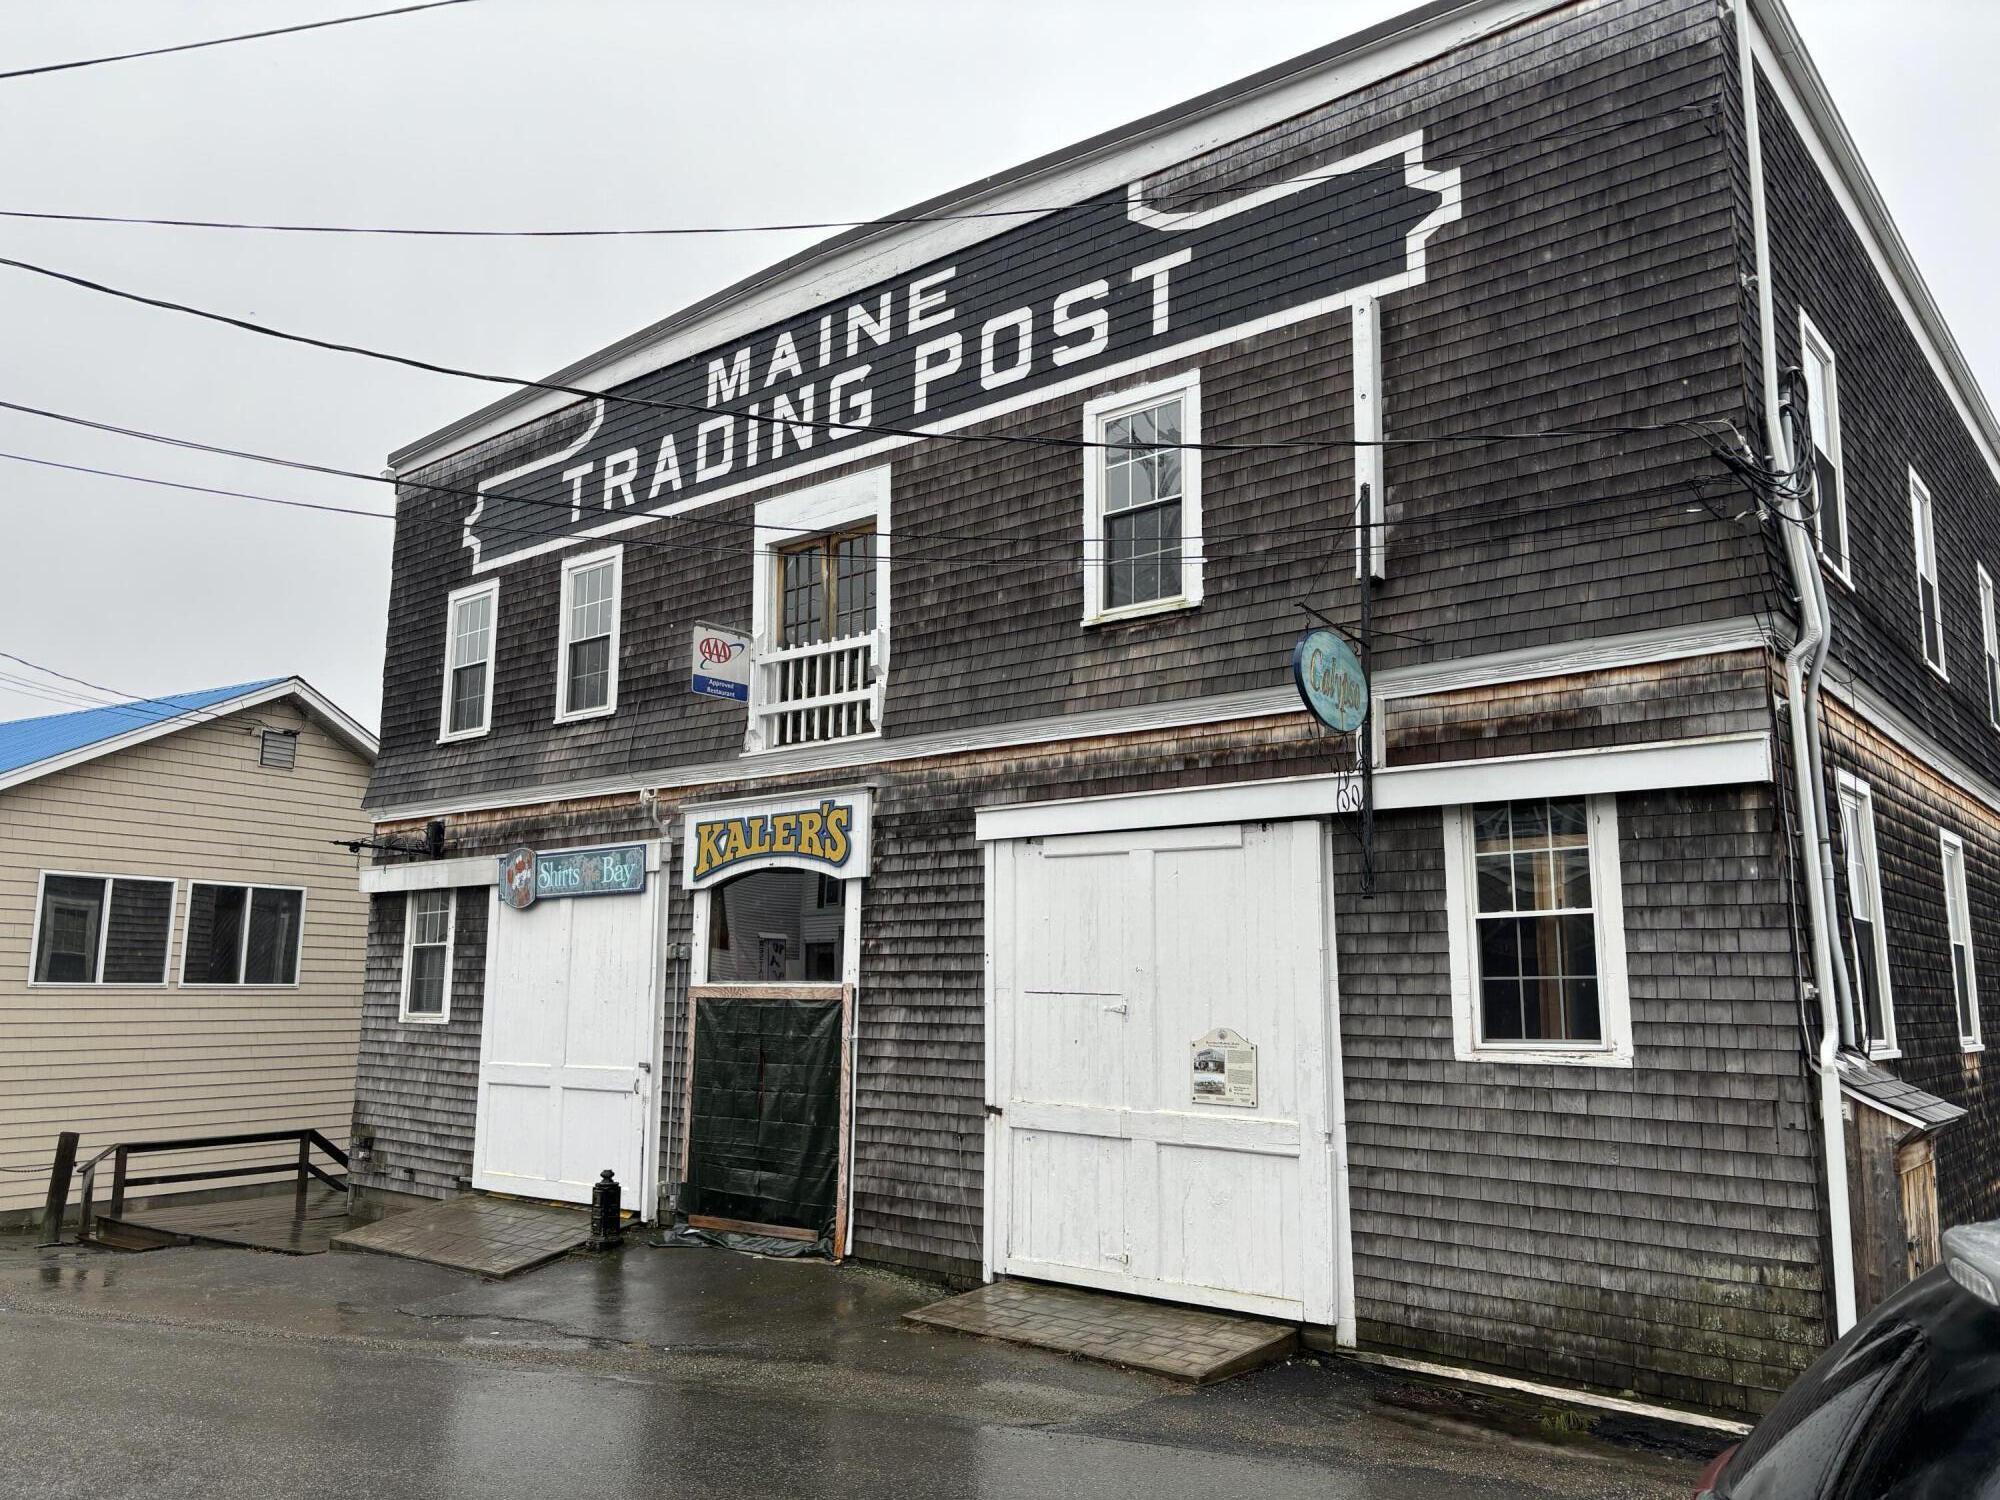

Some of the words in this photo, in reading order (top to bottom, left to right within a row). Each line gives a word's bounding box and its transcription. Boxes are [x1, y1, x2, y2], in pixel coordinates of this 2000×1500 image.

[706, 265, 957, 408] MAINE
[561, 363, 873, 523] TRADING
[913, 246, 1193, 414] POST
[703, 638, 729, 663] AAA
[706, 687, 736, 698] Restaurant
[708, 679, 735, 689] Approved
[1309, 647, 1361, 713] Calypso
[695, 802, 850, 878] KALER'S
[538, 861, 580, 889] Shirts
[601, 856, 636, 887] Bay
